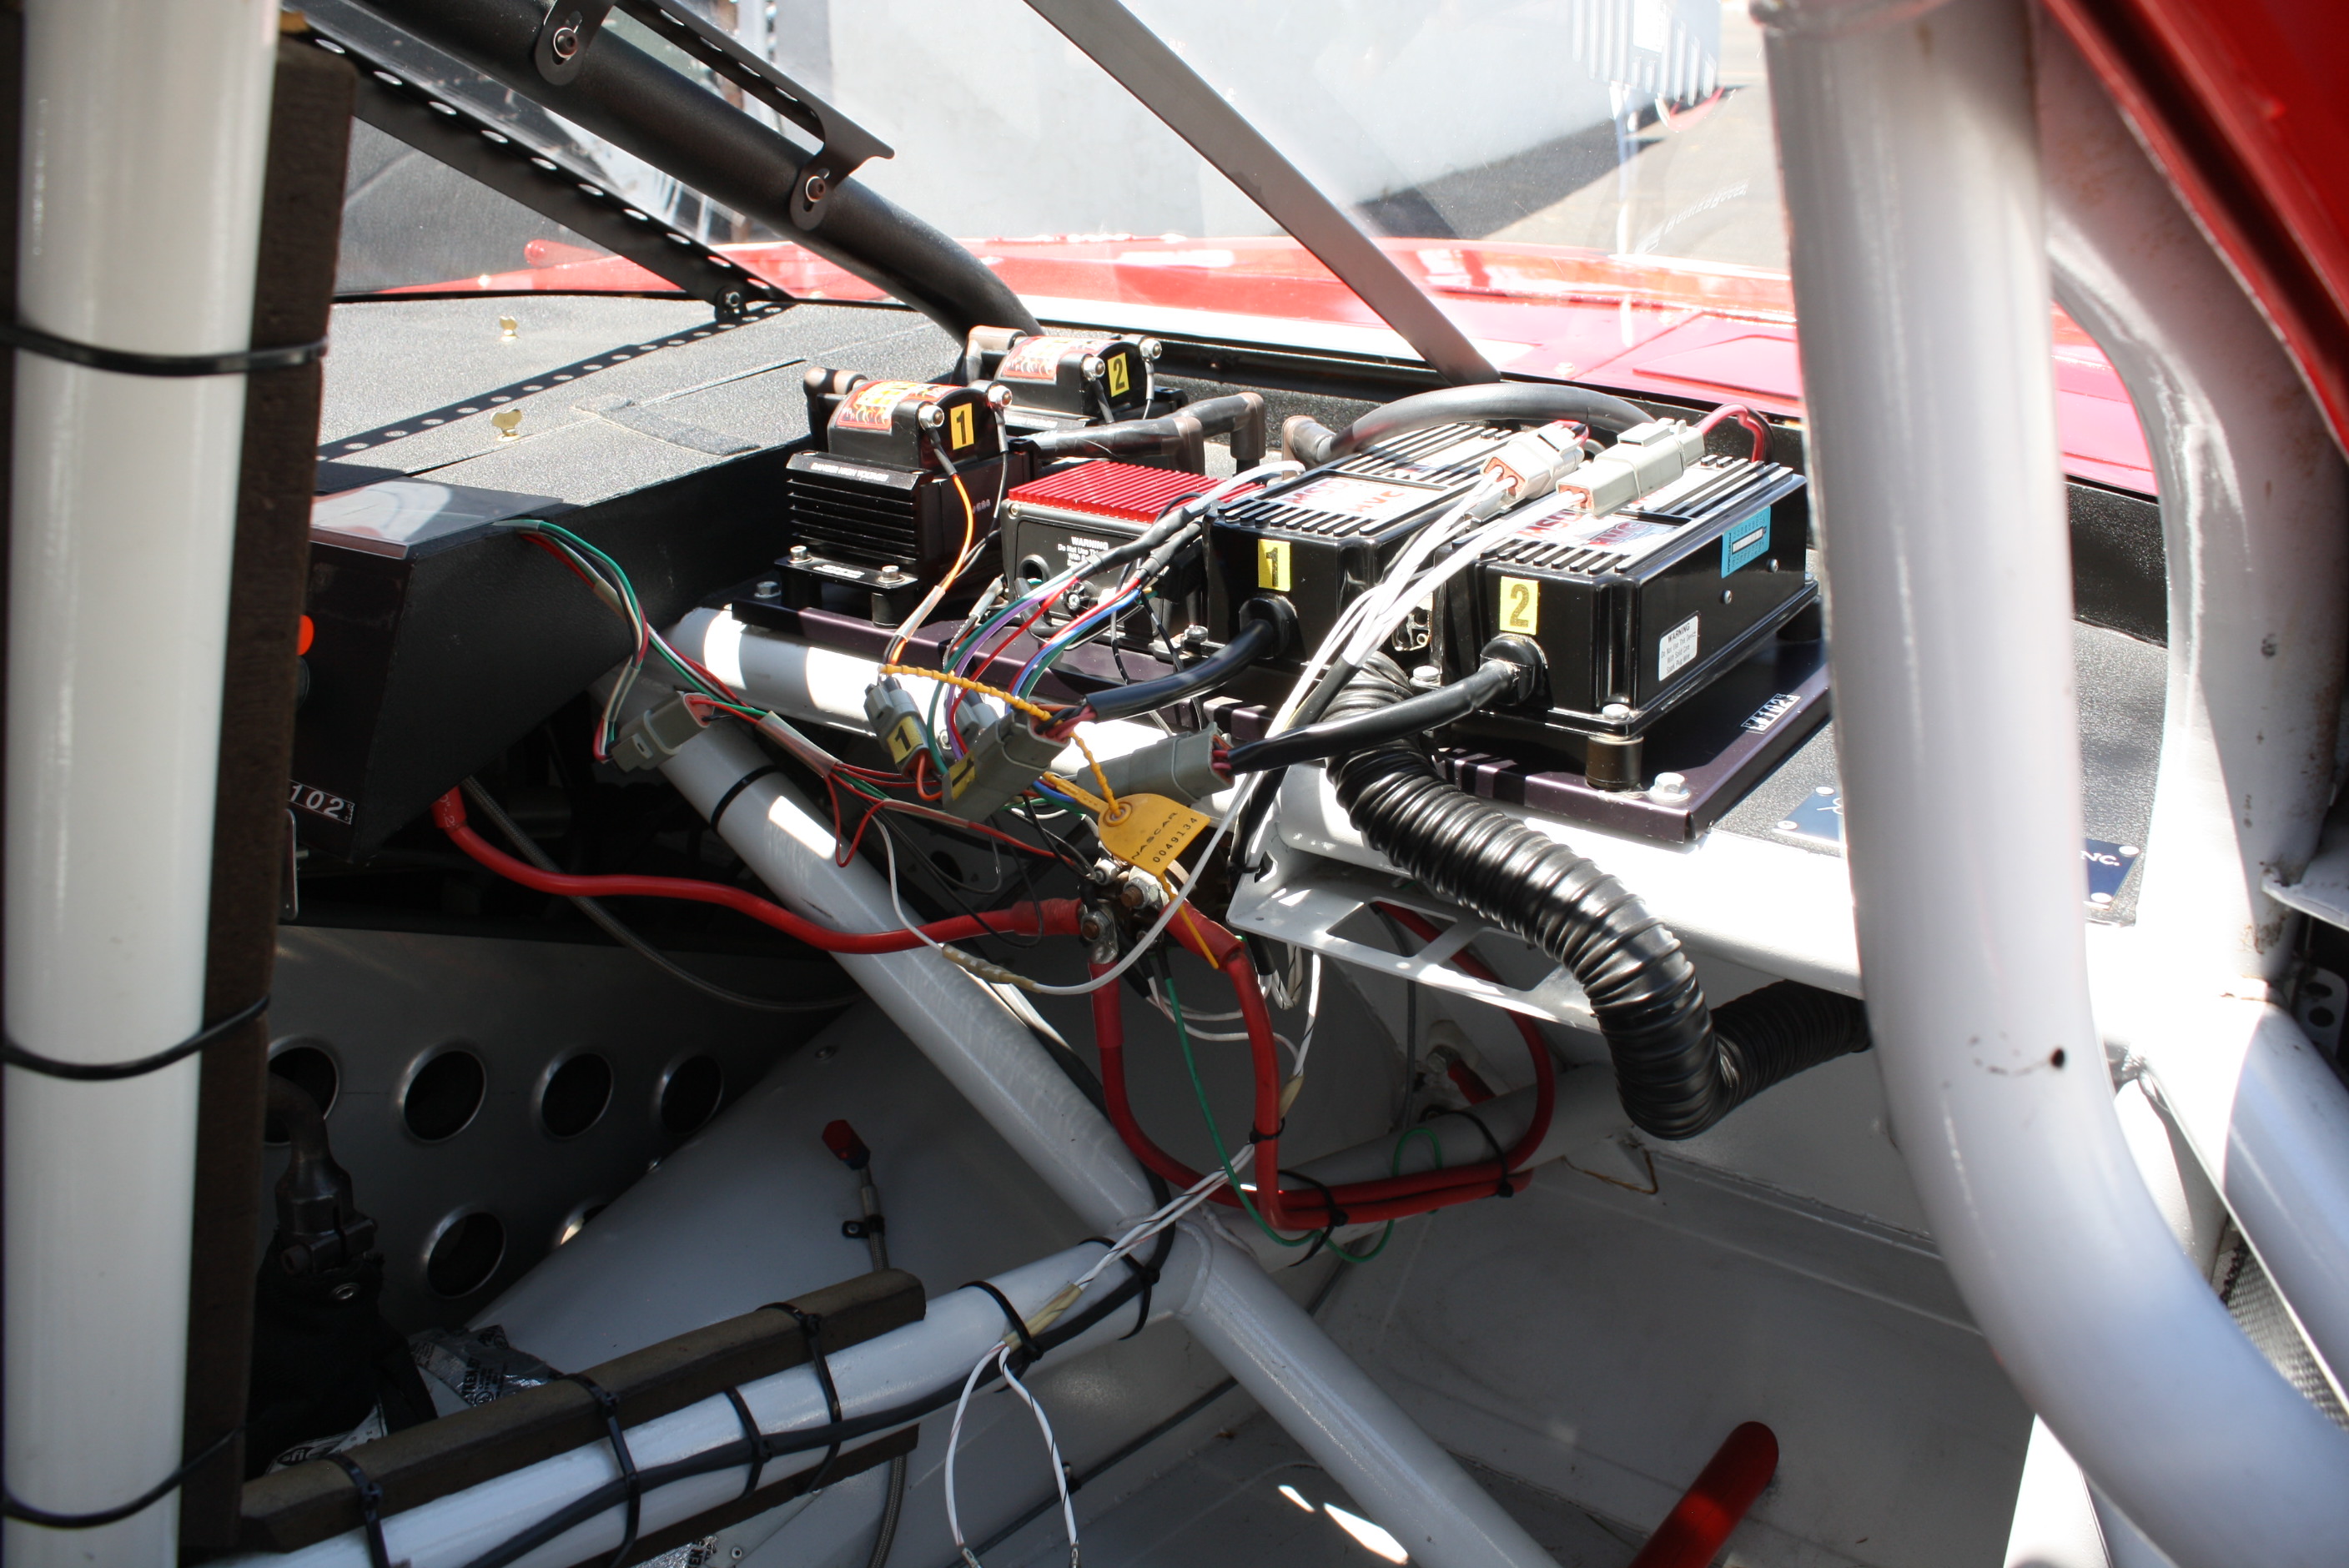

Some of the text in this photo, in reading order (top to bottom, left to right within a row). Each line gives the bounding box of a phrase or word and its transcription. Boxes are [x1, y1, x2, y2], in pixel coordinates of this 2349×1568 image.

[1113, 359, 1125, 389] 2
[957, 410, 966, 445] 1
[1070, 536, 1109, 550] WARNING
[1266, 547, 1278, 587] 1
[1510, 584, 1530, 627] 2
[1667, 622, 1690, 643] WARNING
[894, 725, 912, 751] 1
[952, 757, 975, 788] 1
[1131, 812, 1179, 860] NASCAR
[1153, 817, 1198, 863] 0049134
